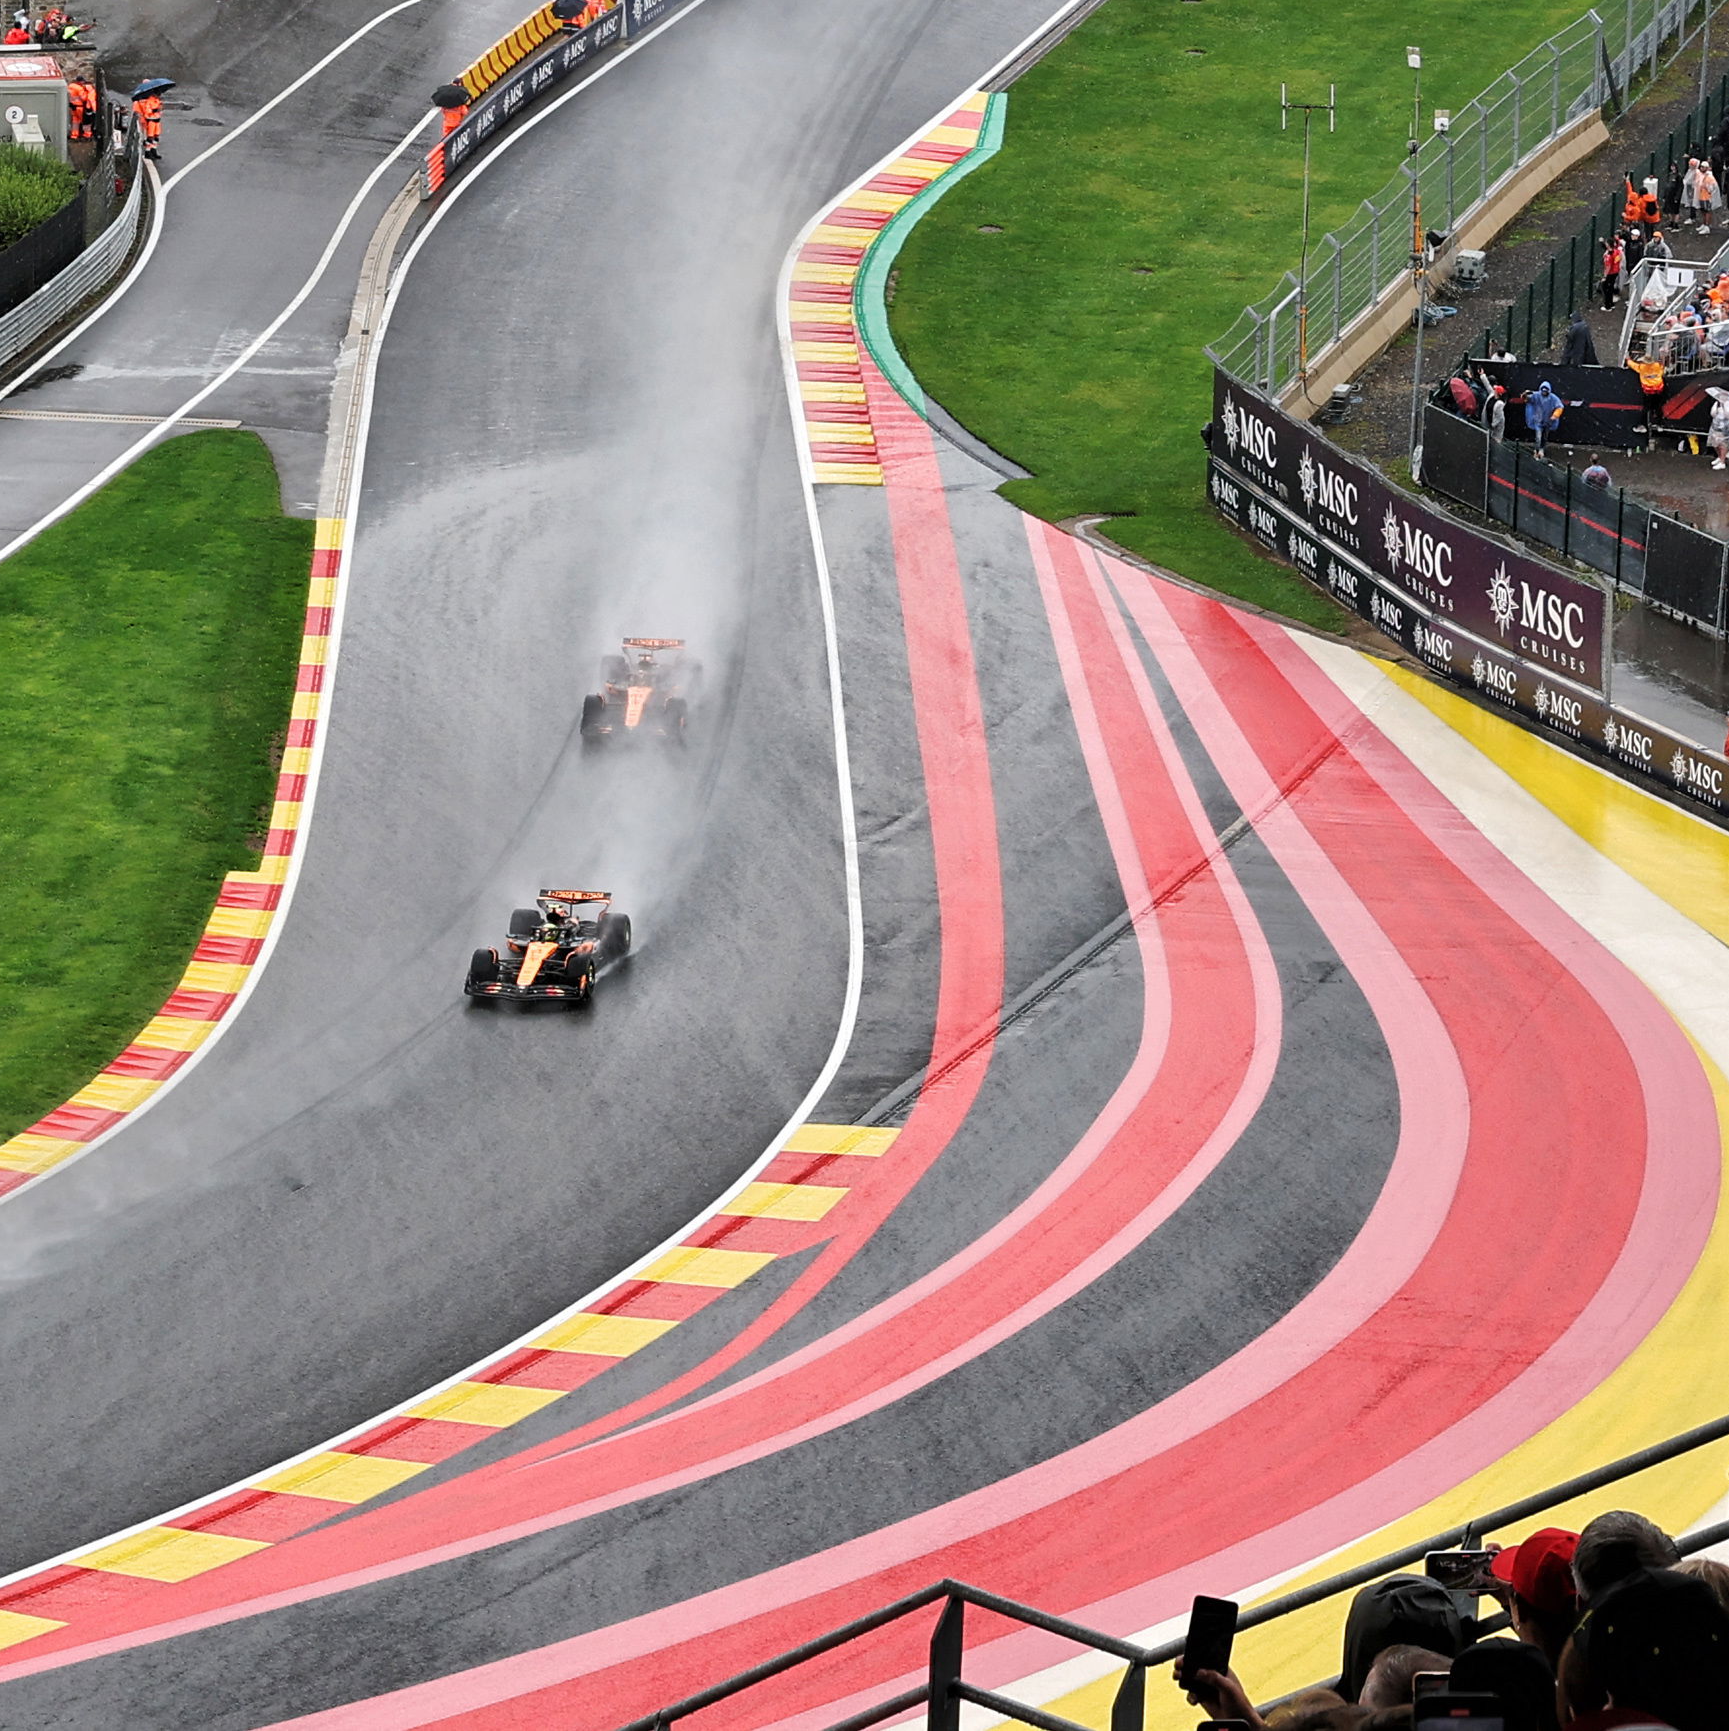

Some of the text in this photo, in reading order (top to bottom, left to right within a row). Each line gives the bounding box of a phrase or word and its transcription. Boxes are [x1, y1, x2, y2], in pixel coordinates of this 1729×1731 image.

[597, 14, 618, 45] MSC
[565, 35, 586, 68] MSC
[533, 58, 555, 91] MSC
[504, 83, 524, 112] MSC
[478, 107, 496, 133] MSC
[455, 127, 472, 154] MSC
[1239, 406, 1278, 469] MSC
[1241, 455, 1280, 492] CRUISES
[1221, 477, 1239, 510] MSC
[1317, 462, 1359, 527] MSC
[1256, 508, 1277, 539] MSC
[1319, 514, 1361, 551] CRUISES
[1296, 538, 1318, 570] MSC
[1403, 522, 1453, 587] MSC
[1336, 567, 1358, 600] MSC
[1405, 572, 1454, 613] CRUISES
[1379, 599, 1402, 632] MSC
[1520, 582, 1585, 649] MSC
[1424, 627, 1453, 662] MSC
[1520, 637, 1586, 676] CRUISES
[1486, 665, 1517, 695] MSC
[1550, 698, 1582, 727] MSC
[1619, 725, 1653, 761] MSC
[1687, 761, 1723, 795] MSC
